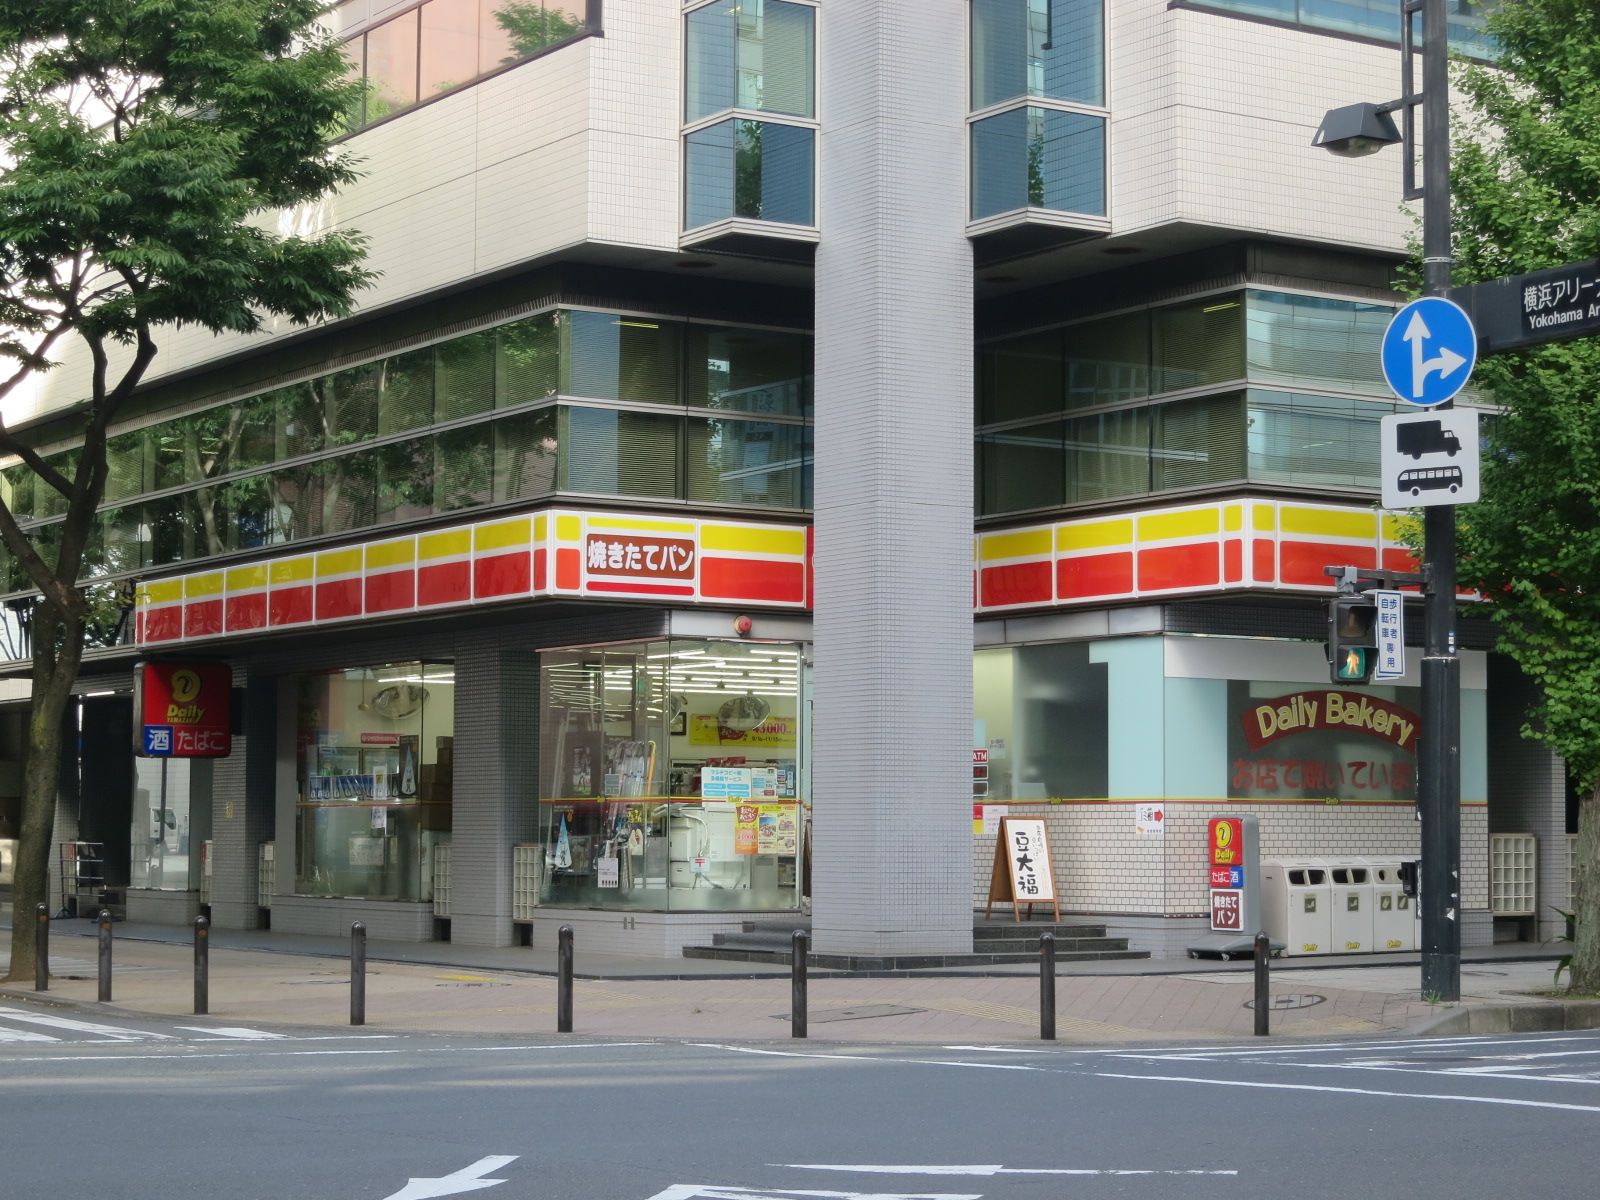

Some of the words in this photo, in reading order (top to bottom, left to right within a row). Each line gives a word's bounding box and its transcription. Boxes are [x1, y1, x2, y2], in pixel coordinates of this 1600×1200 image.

[1529, 309, 1583, 329] Yokohama
[588, 539, 693, 572] 焼きたてパン
[1381, 598, 1389, 639] 自転車
[1389, 598, 1397, 639] 歩行者
[167, 704, 206, 723] Daily
[1256, 695, 1317, 738] Daily
[1325, 692, 1413, 746] Bakery
[148, 729, 170, 751] 酒
[177, 730, 224, 751] たばこ
[973, 752, 987, 761] ATM
[1015, 831, 1039, 895] 豆大福
[1215, 848, 1234, 863] Daily
[1212, 871, 1229, 883] たばこ
[1230, 871, 1239, 883] 酒
[1214, 896, 1237, 908] 焼きたて
[1217, 910, 1235, 925] パン
